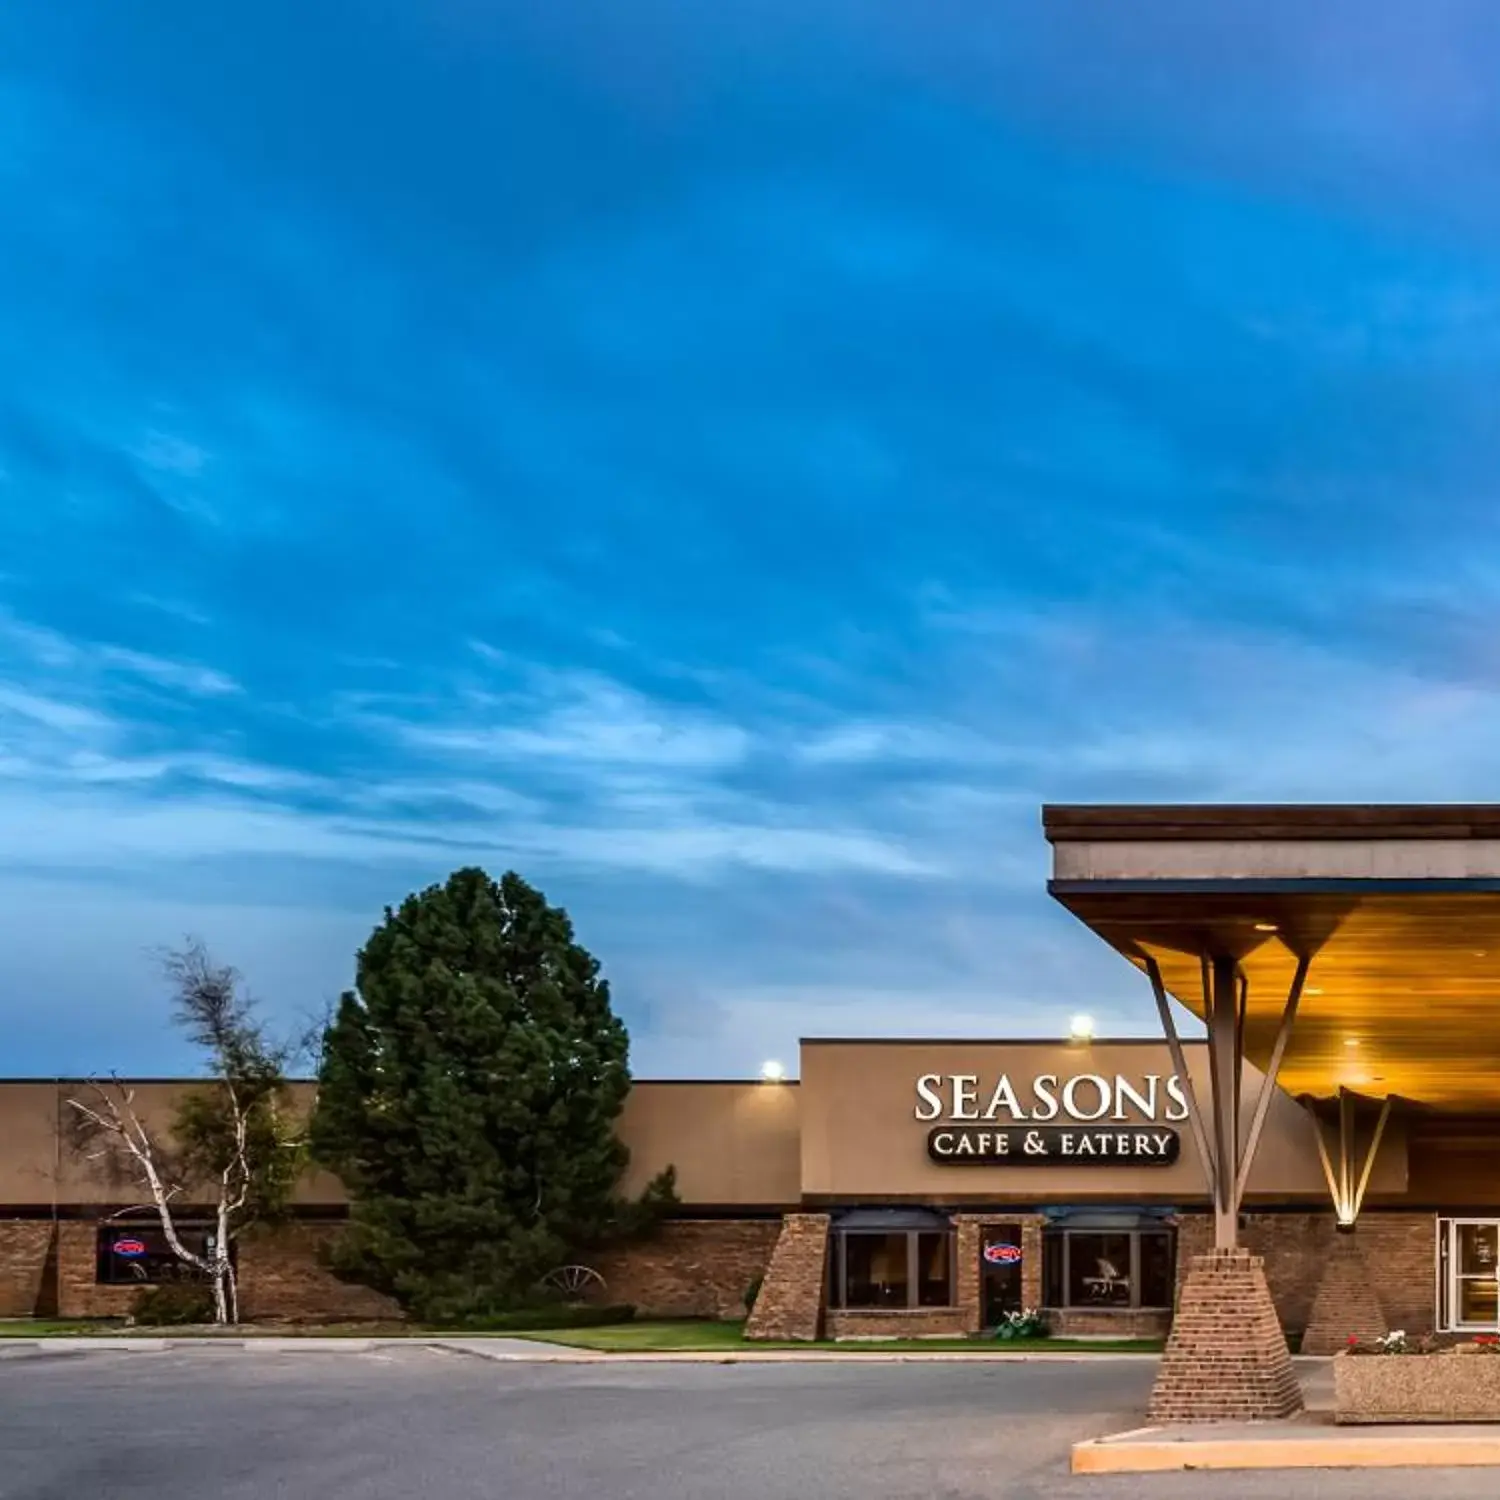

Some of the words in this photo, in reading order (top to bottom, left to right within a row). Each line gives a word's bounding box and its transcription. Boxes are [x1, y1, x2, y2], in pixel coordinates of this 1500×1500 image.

[915, 1073, 1189, 1120] SEASONS
[933, 1132, 1009, 1155] CAFE
[1023, 1130, 1048, 1155] &
[1060, 1132, 1172, 1155] EATERY
